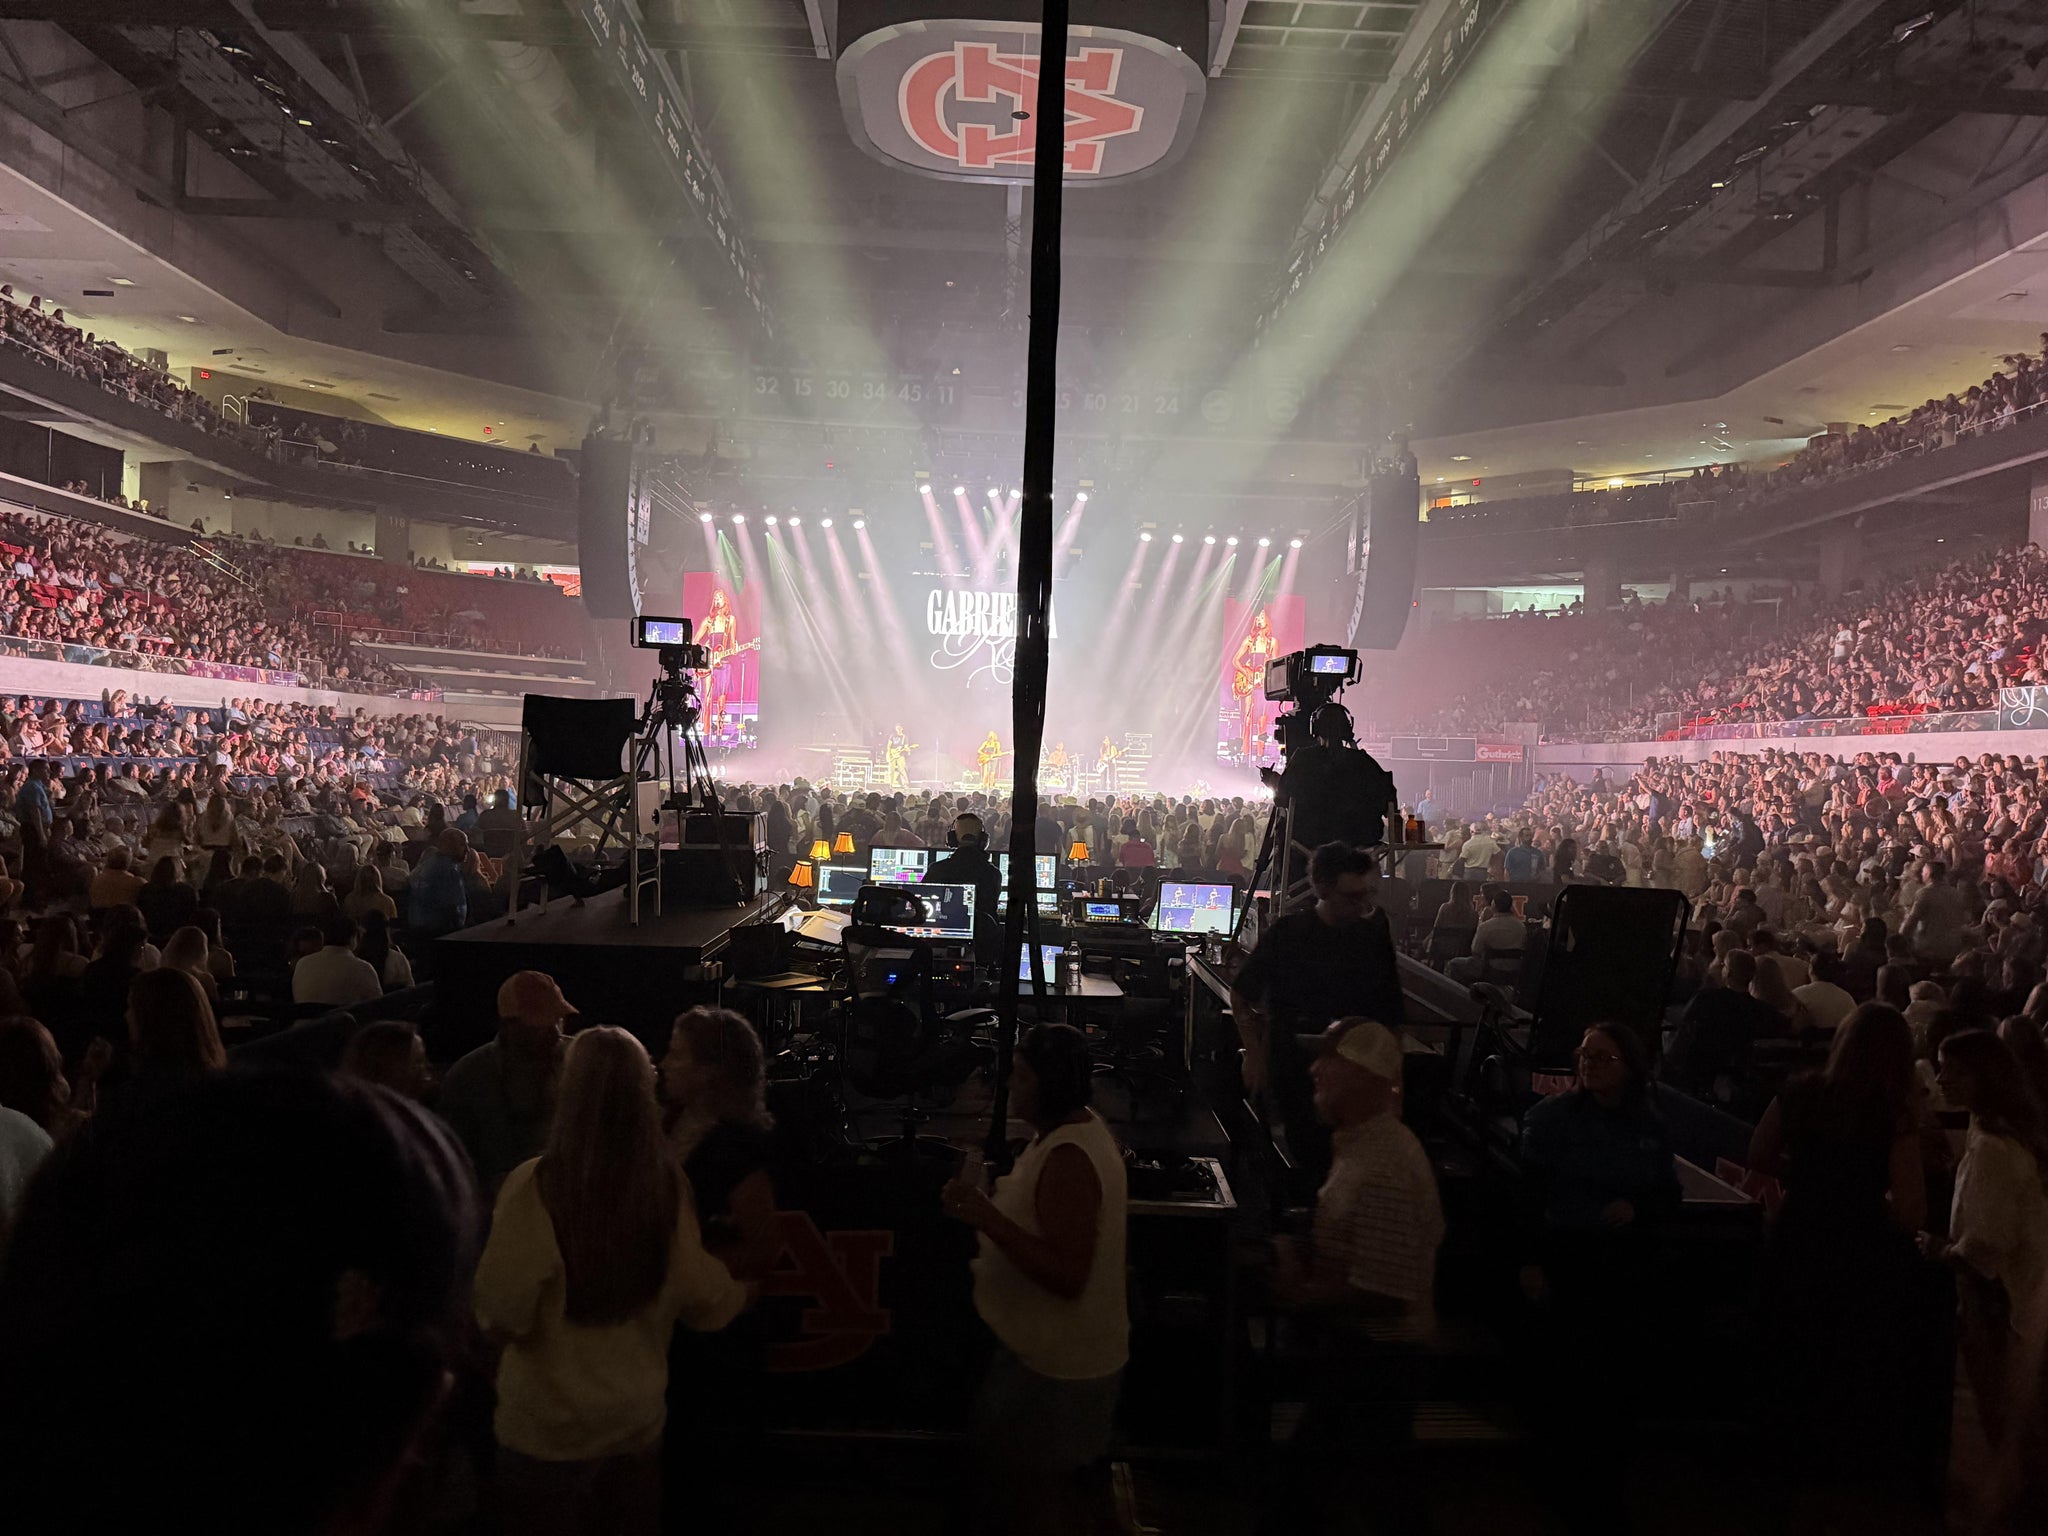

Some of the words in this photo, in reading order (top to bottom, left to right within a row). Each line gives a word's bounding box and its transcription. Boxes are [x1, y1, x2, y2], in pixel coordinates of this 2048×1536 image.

[756, 376, 779, 395] 32
[794, 378, 812, 396] 15
[826, 380, 850, 399] 30
[863, 382, 886, 401] 34
[898, 383, 922, 402] 45
[1154, 395, 1180, 414] 24
[926, 589, 1058, 639] GABRIEA
